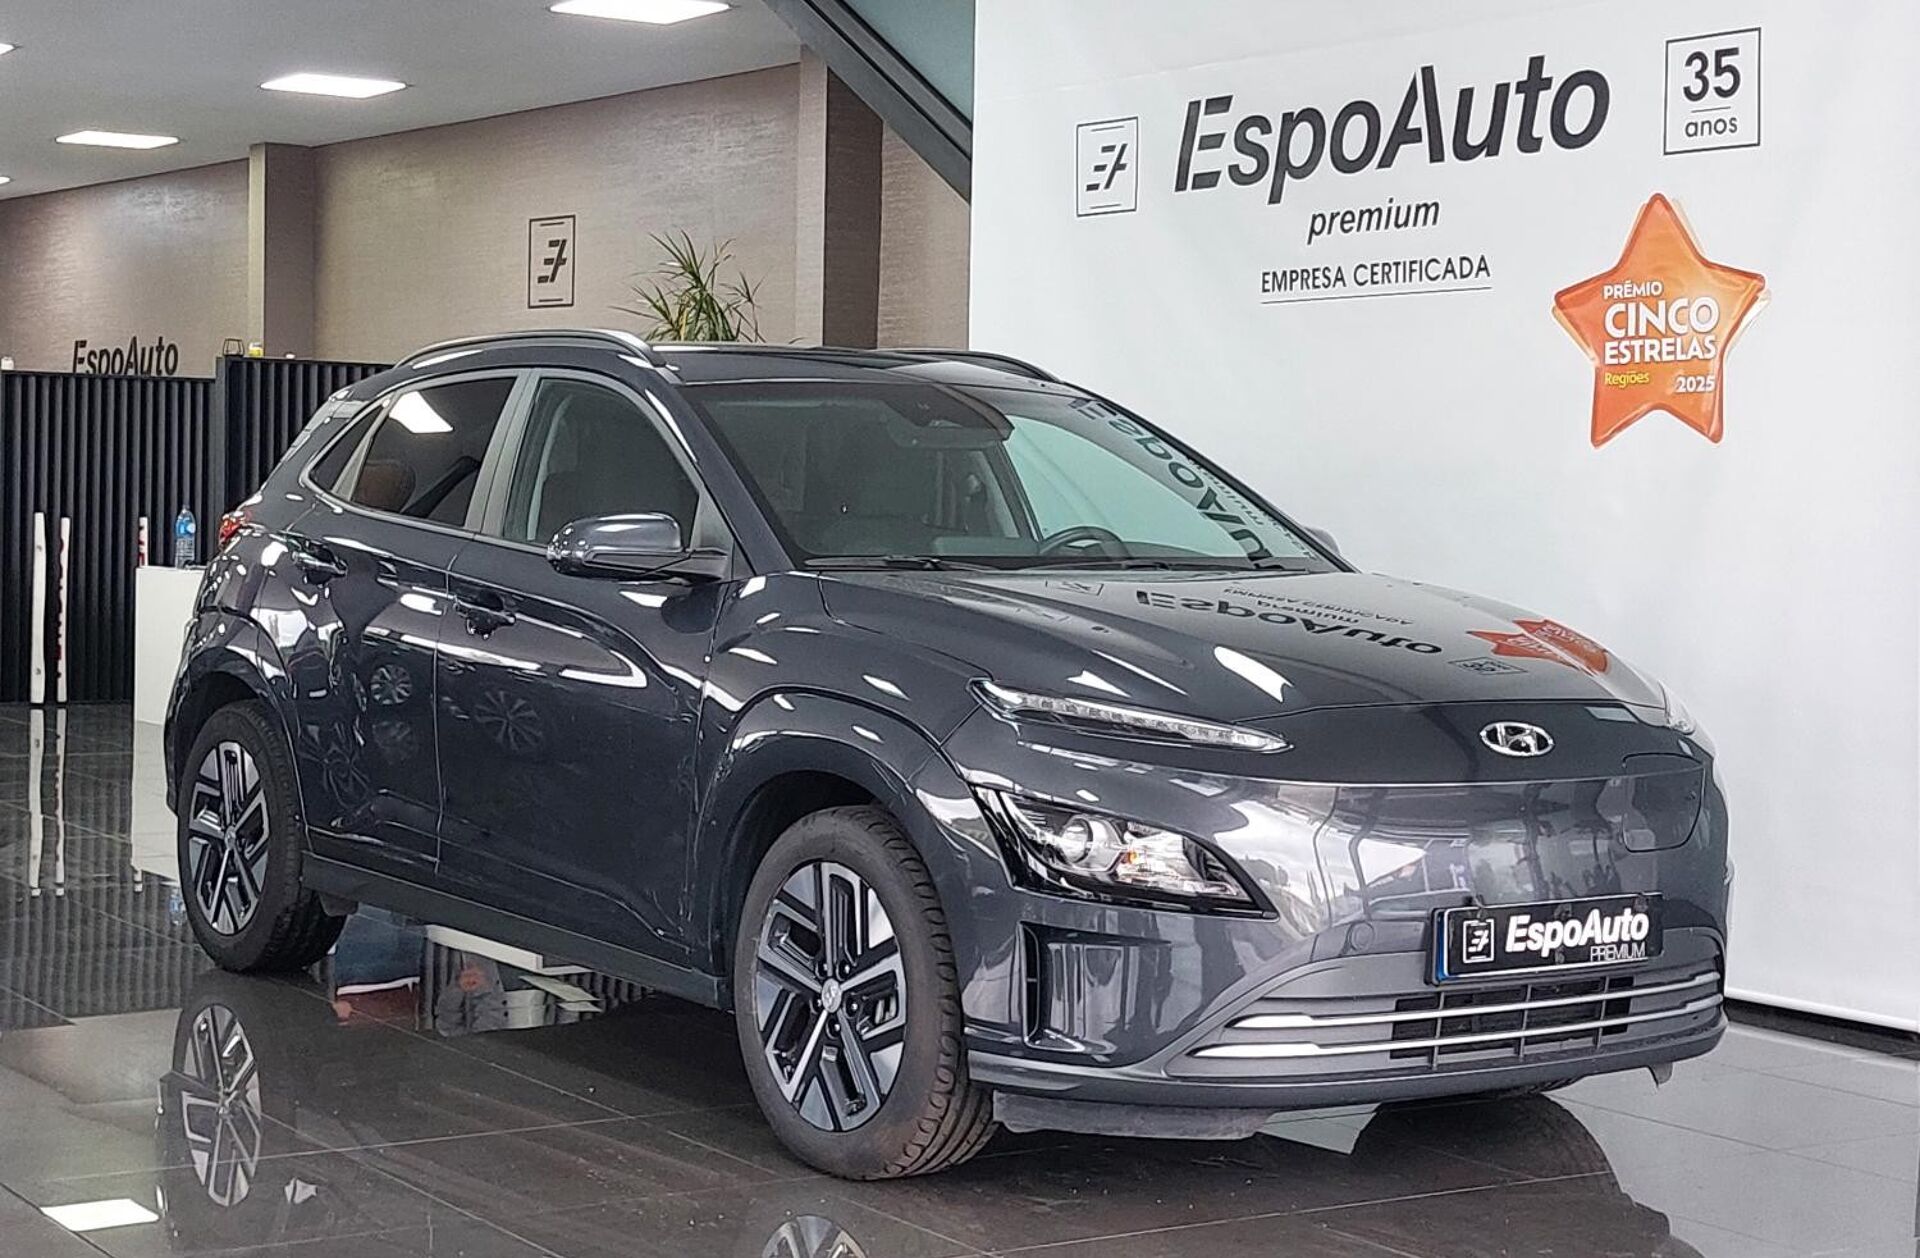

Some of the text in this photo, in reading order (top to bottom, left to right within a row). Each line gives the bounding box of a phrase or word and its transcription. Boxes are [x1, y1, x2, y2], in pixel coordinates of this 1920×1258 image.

[1682, 46, 1741, 102] 35
[1173, 54, 1611, 206] EspoAuto
[1684, 116, 1739, 138] anos
[1306, 197, 1441, 246] premium
[1261, 254, 1492, 294] EMPRESA CERTIFICADA
[1603, 279, 1663, 300] PRÉMIO
[1604, 296, 1720, 338] CINCO
[1604, 335, 1717, 365] ESTRELAS
[1604, 371, 1650, 388] Regiões
[1675, 376, 1717, 393] 2025
[1504, 907, 1650, 958] EspoAuto
[1590, 942, 1646, 962] PREMIUM
